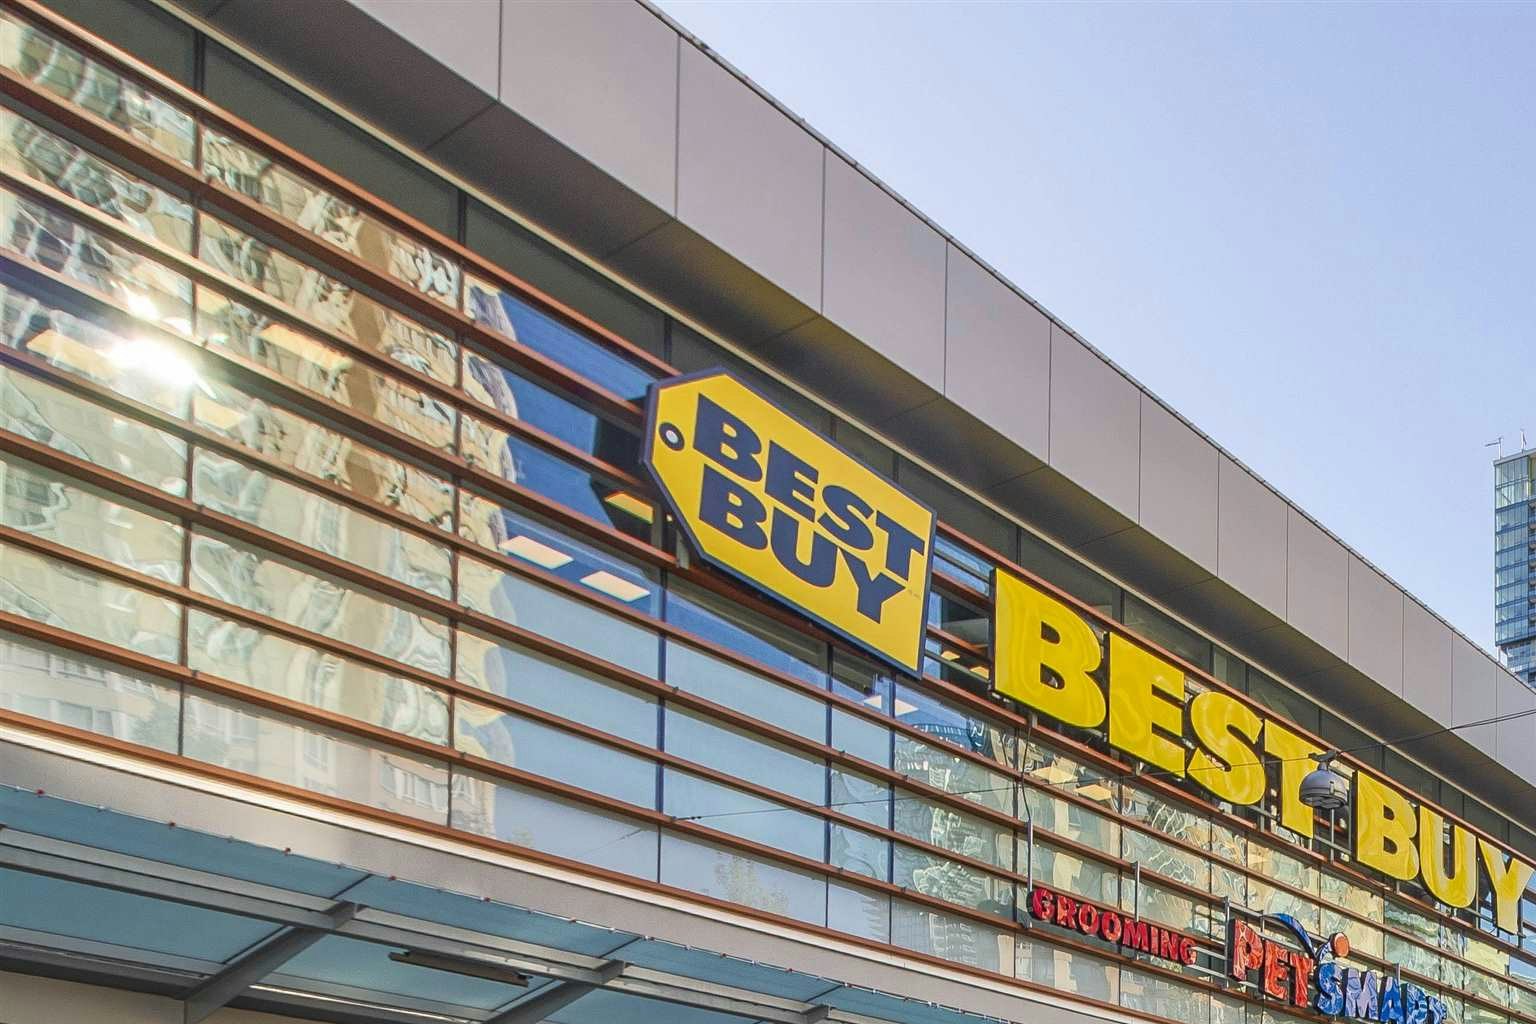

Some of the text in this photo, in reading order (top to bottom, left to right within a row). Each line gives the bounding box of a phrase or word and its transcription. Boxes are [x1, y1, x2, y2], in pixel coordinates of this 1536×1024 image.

[693, 392, 925, 581] BEST
[699, 463, 906, 624] BUY
[992, 567, 1534, 935] BEST BUY
[1030, 887, 1198, 965] GROOMING
